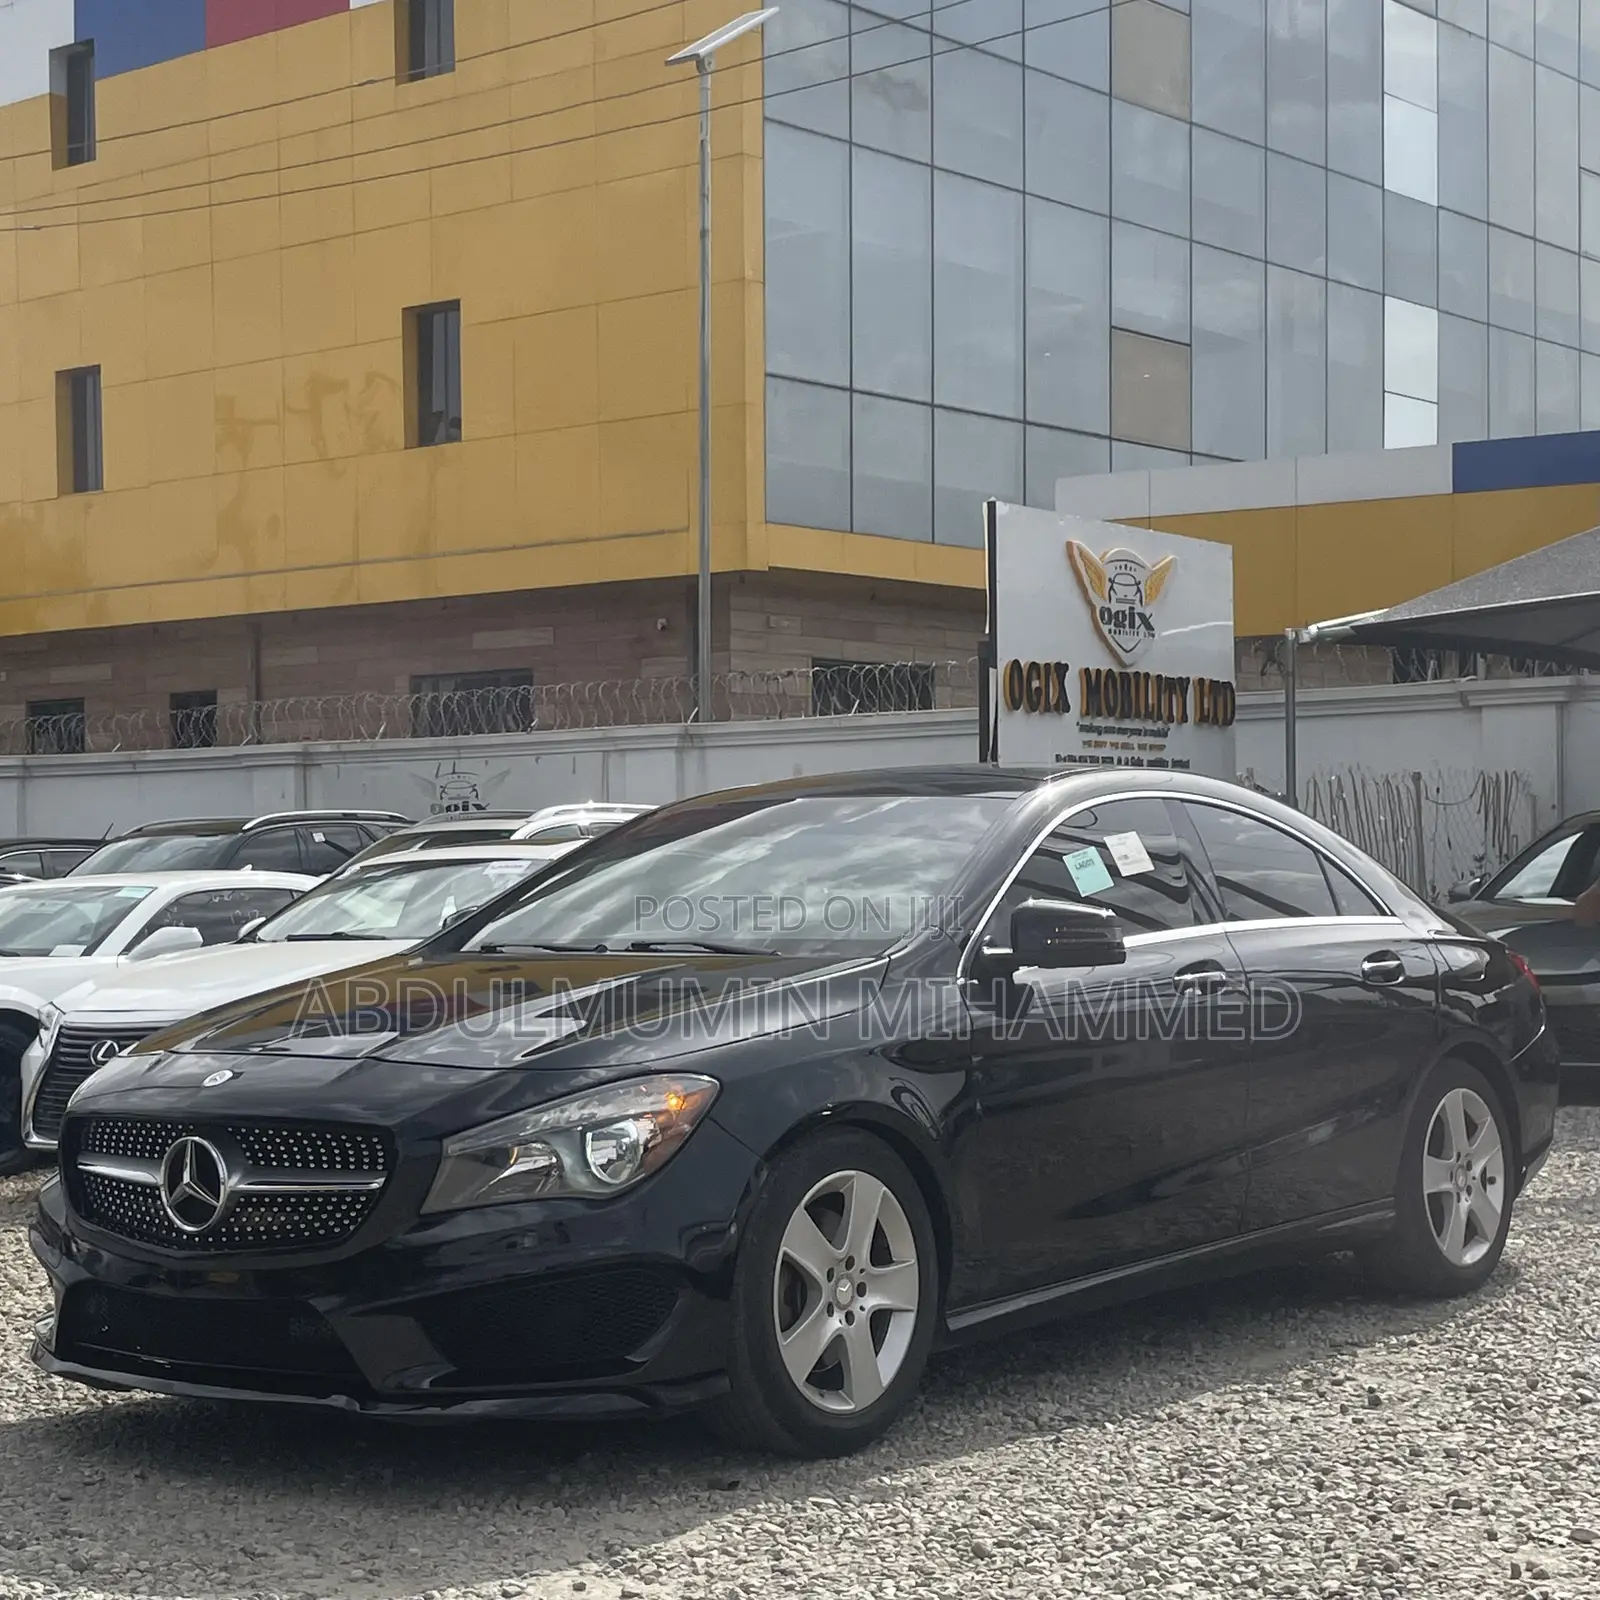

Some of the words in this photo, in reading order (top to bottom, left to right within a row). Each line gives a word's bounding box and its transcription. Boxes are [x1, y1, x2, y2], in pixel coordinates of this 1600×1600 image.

[1003, 659, 1071, 714] OGIX
[1079, 668, 1190, 724] MOBILITY
[1192, 677, 1236, 727] LTD
